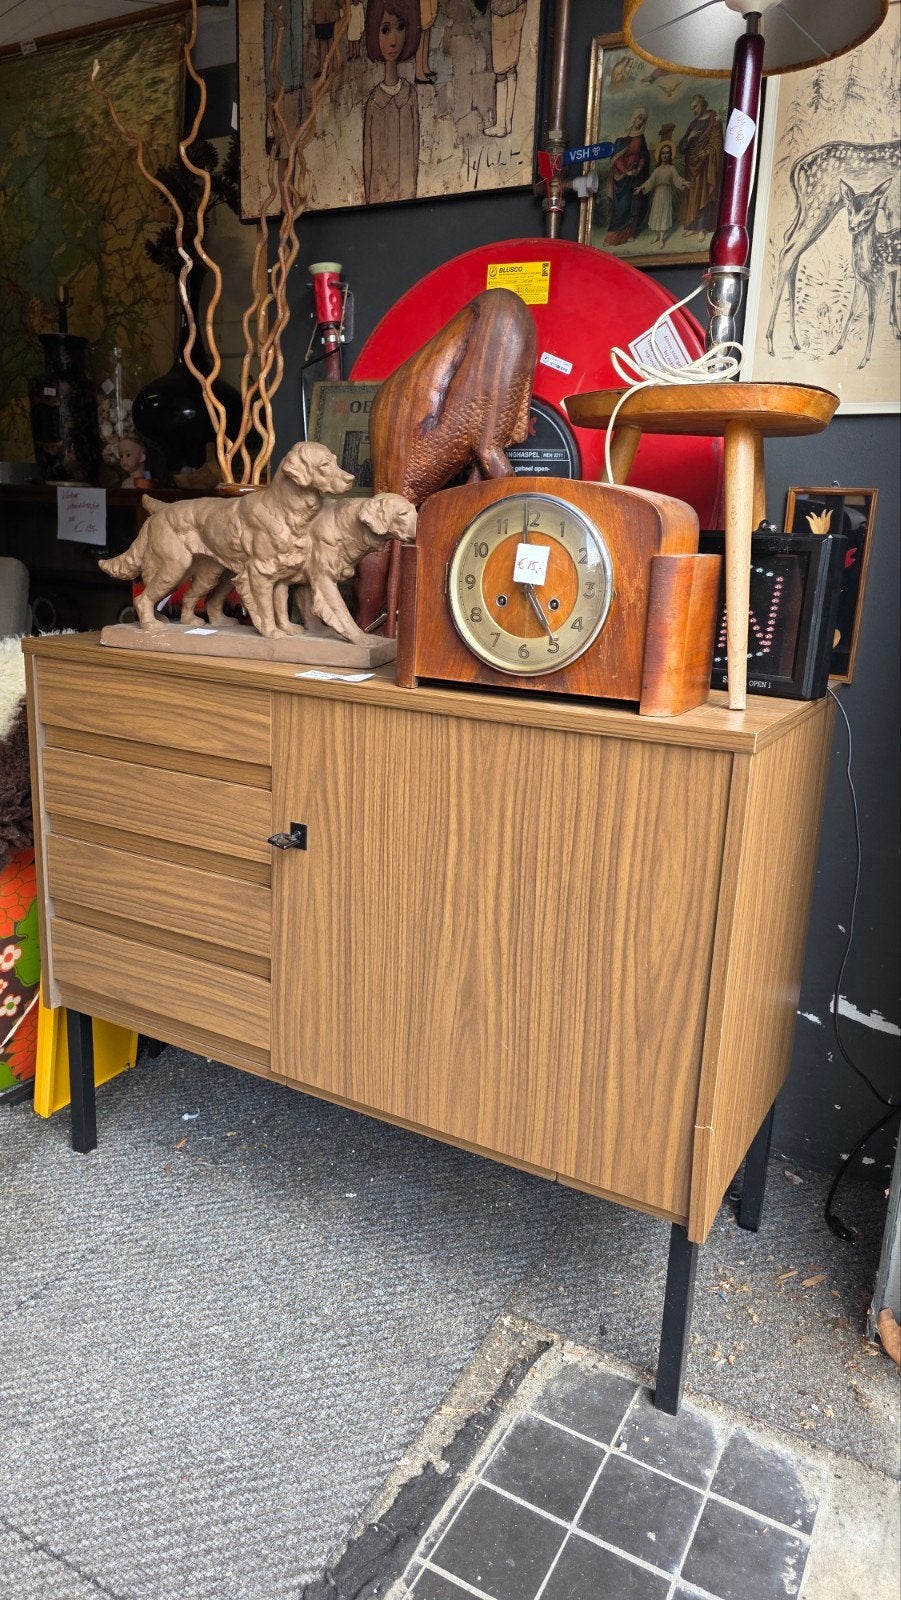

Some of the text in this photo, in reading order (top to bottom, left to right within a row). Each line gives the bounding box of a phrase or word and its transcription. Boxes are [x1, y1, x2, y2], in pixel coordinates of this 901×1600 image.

[569, 148, 590, 161] VSH
[498, 266, 523, 274] BLUSCO
[507, 451, 540, 459] NGHASPEL
[514, 464, 534, 473] geheel
[496, 518, 509, 535] 11
[559, 520, 566, 538] 1
[473, 541, 489, 559] 10
[577, 547, 589, 565] 2
[464, 573, 476, 590] 9
[582, 581, 595, 599] 3
[469, 606, 483, 623] 8
[570, 616, 583, 633] 4
[489, 632, 501, 648] 7
[546, 637, 560, 654] 5
[517, 643, 530, 660] 6
[748, 680, 767, 688] OPEN
